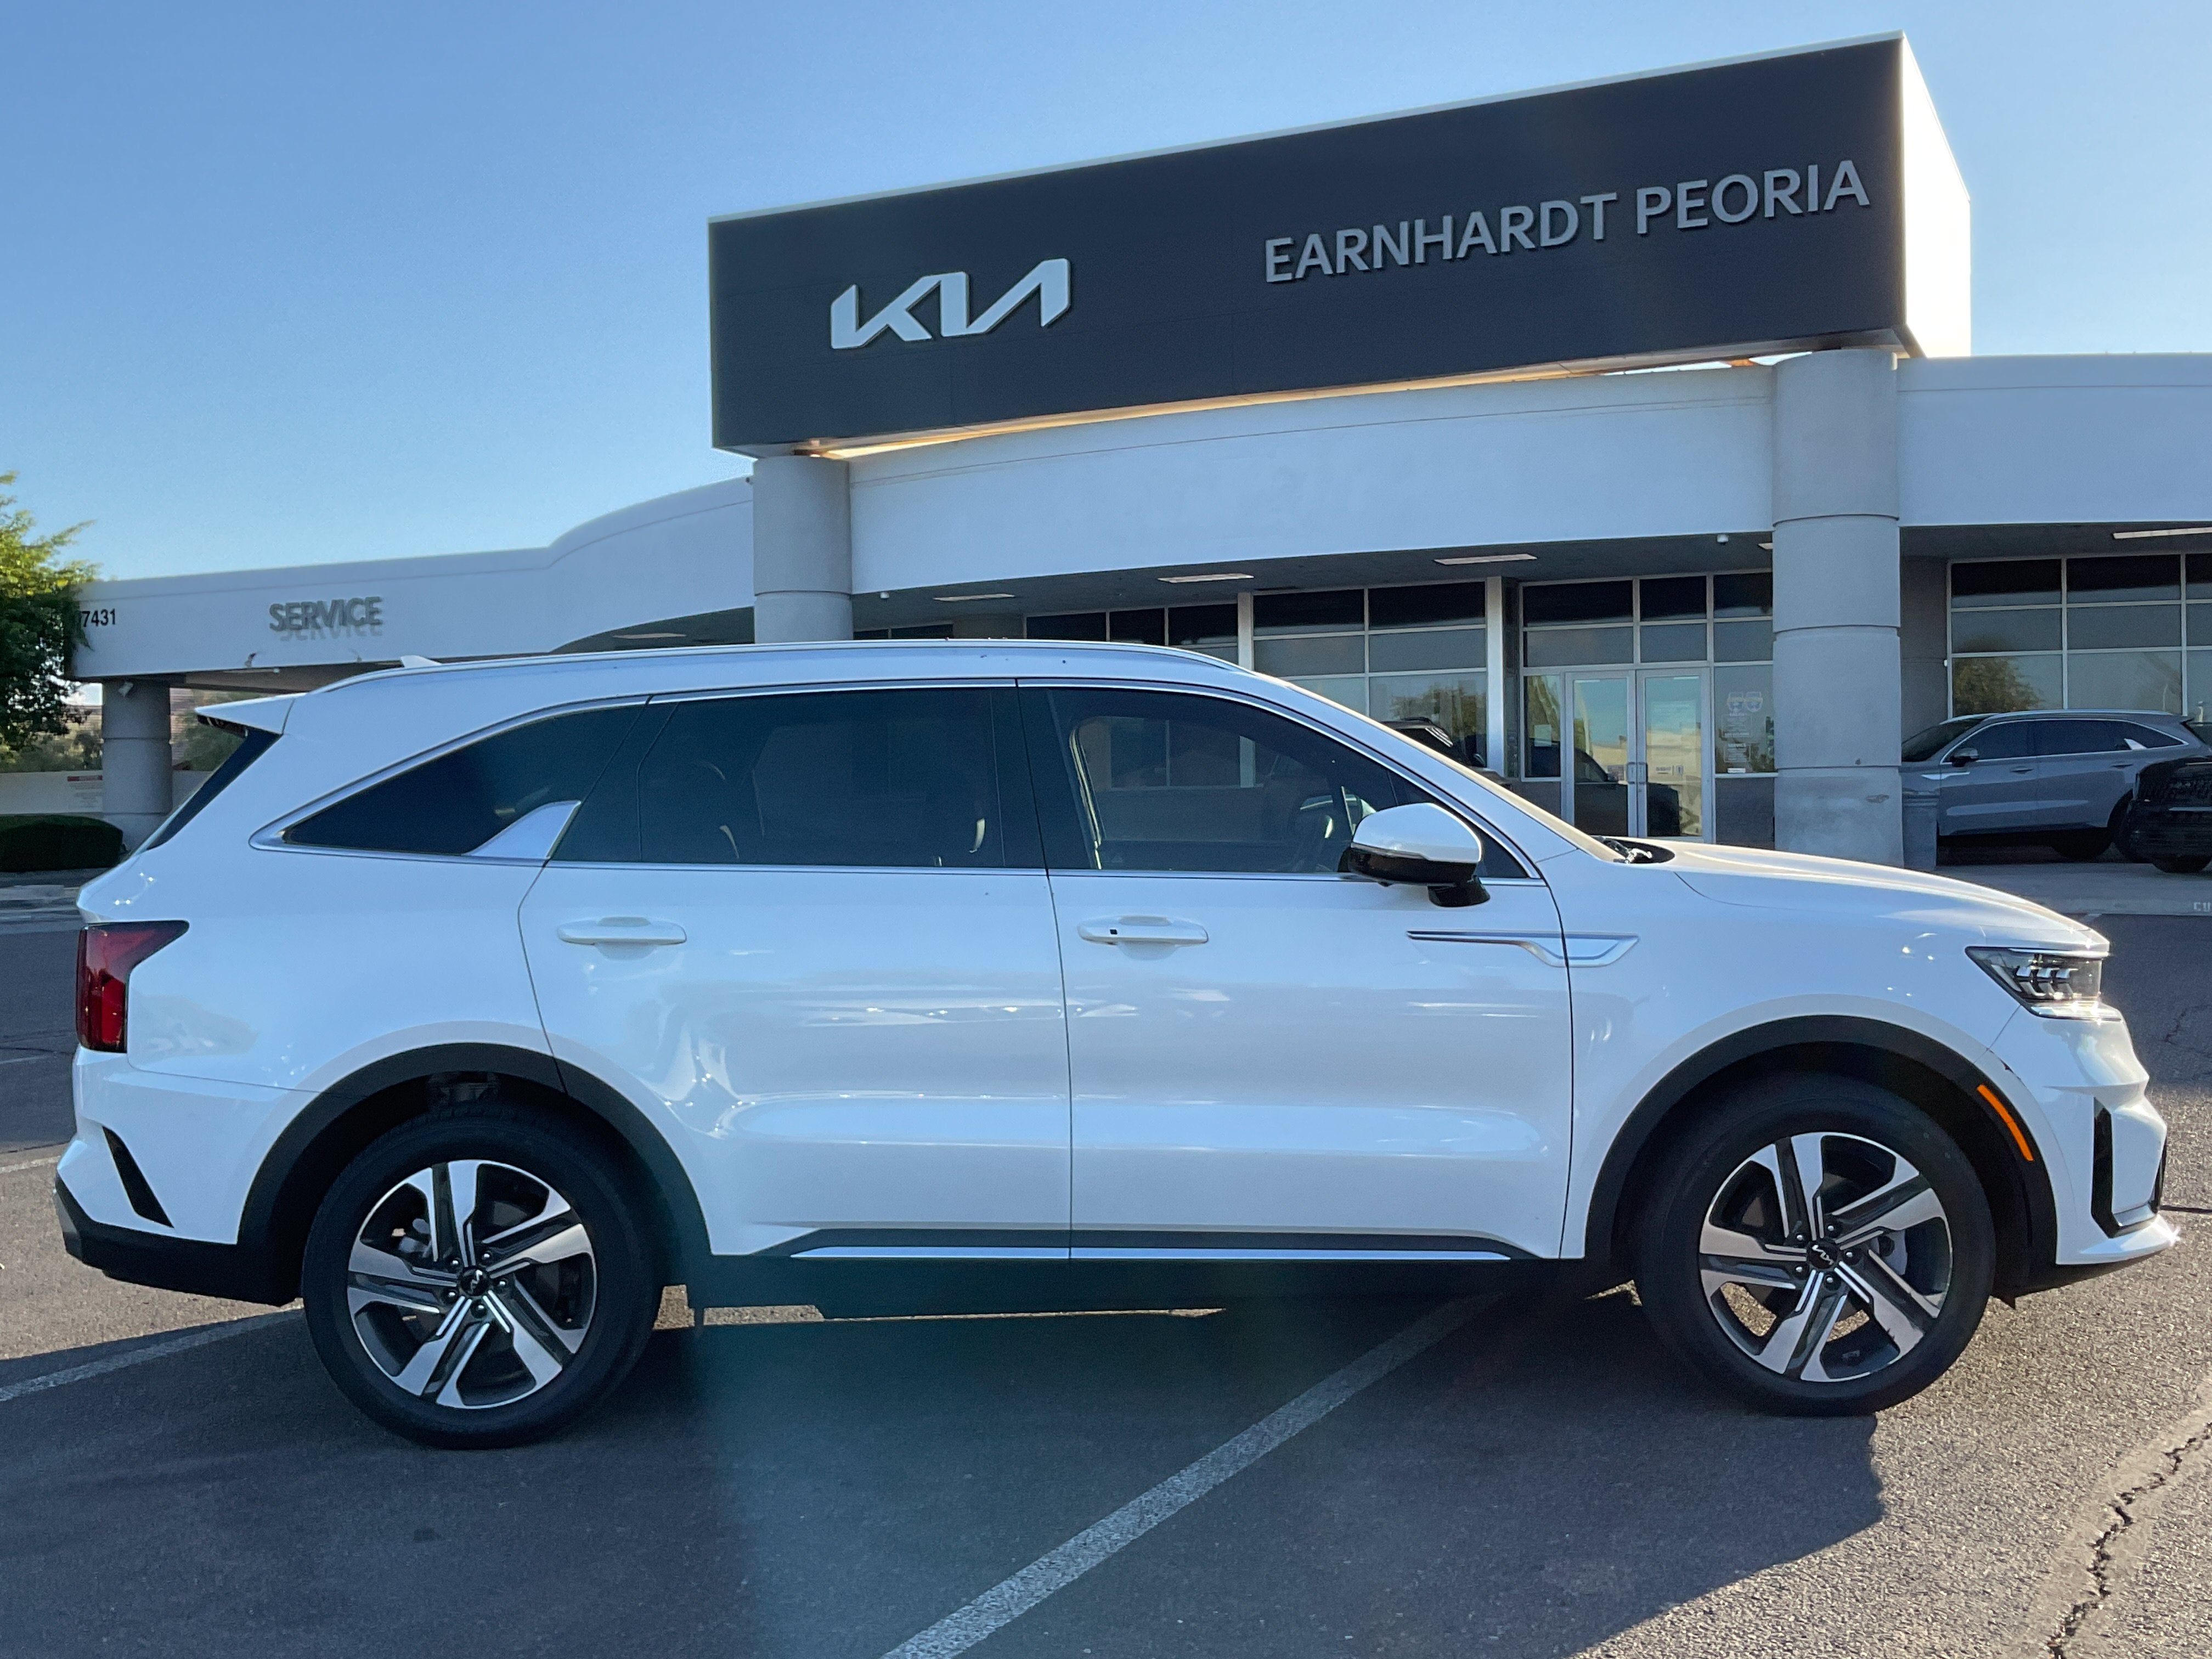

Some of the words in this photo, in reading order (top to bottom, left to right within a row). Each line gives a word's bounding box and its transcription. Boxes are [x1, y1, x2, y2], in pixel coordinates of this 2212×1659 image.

[1265, 192, 1617, 283] EARNHARDT
[1637, 160, 1870, 235] PEORIA
[831, 257, 1071, 349] KIA
[269, 596, 383, 632] SERVICE
